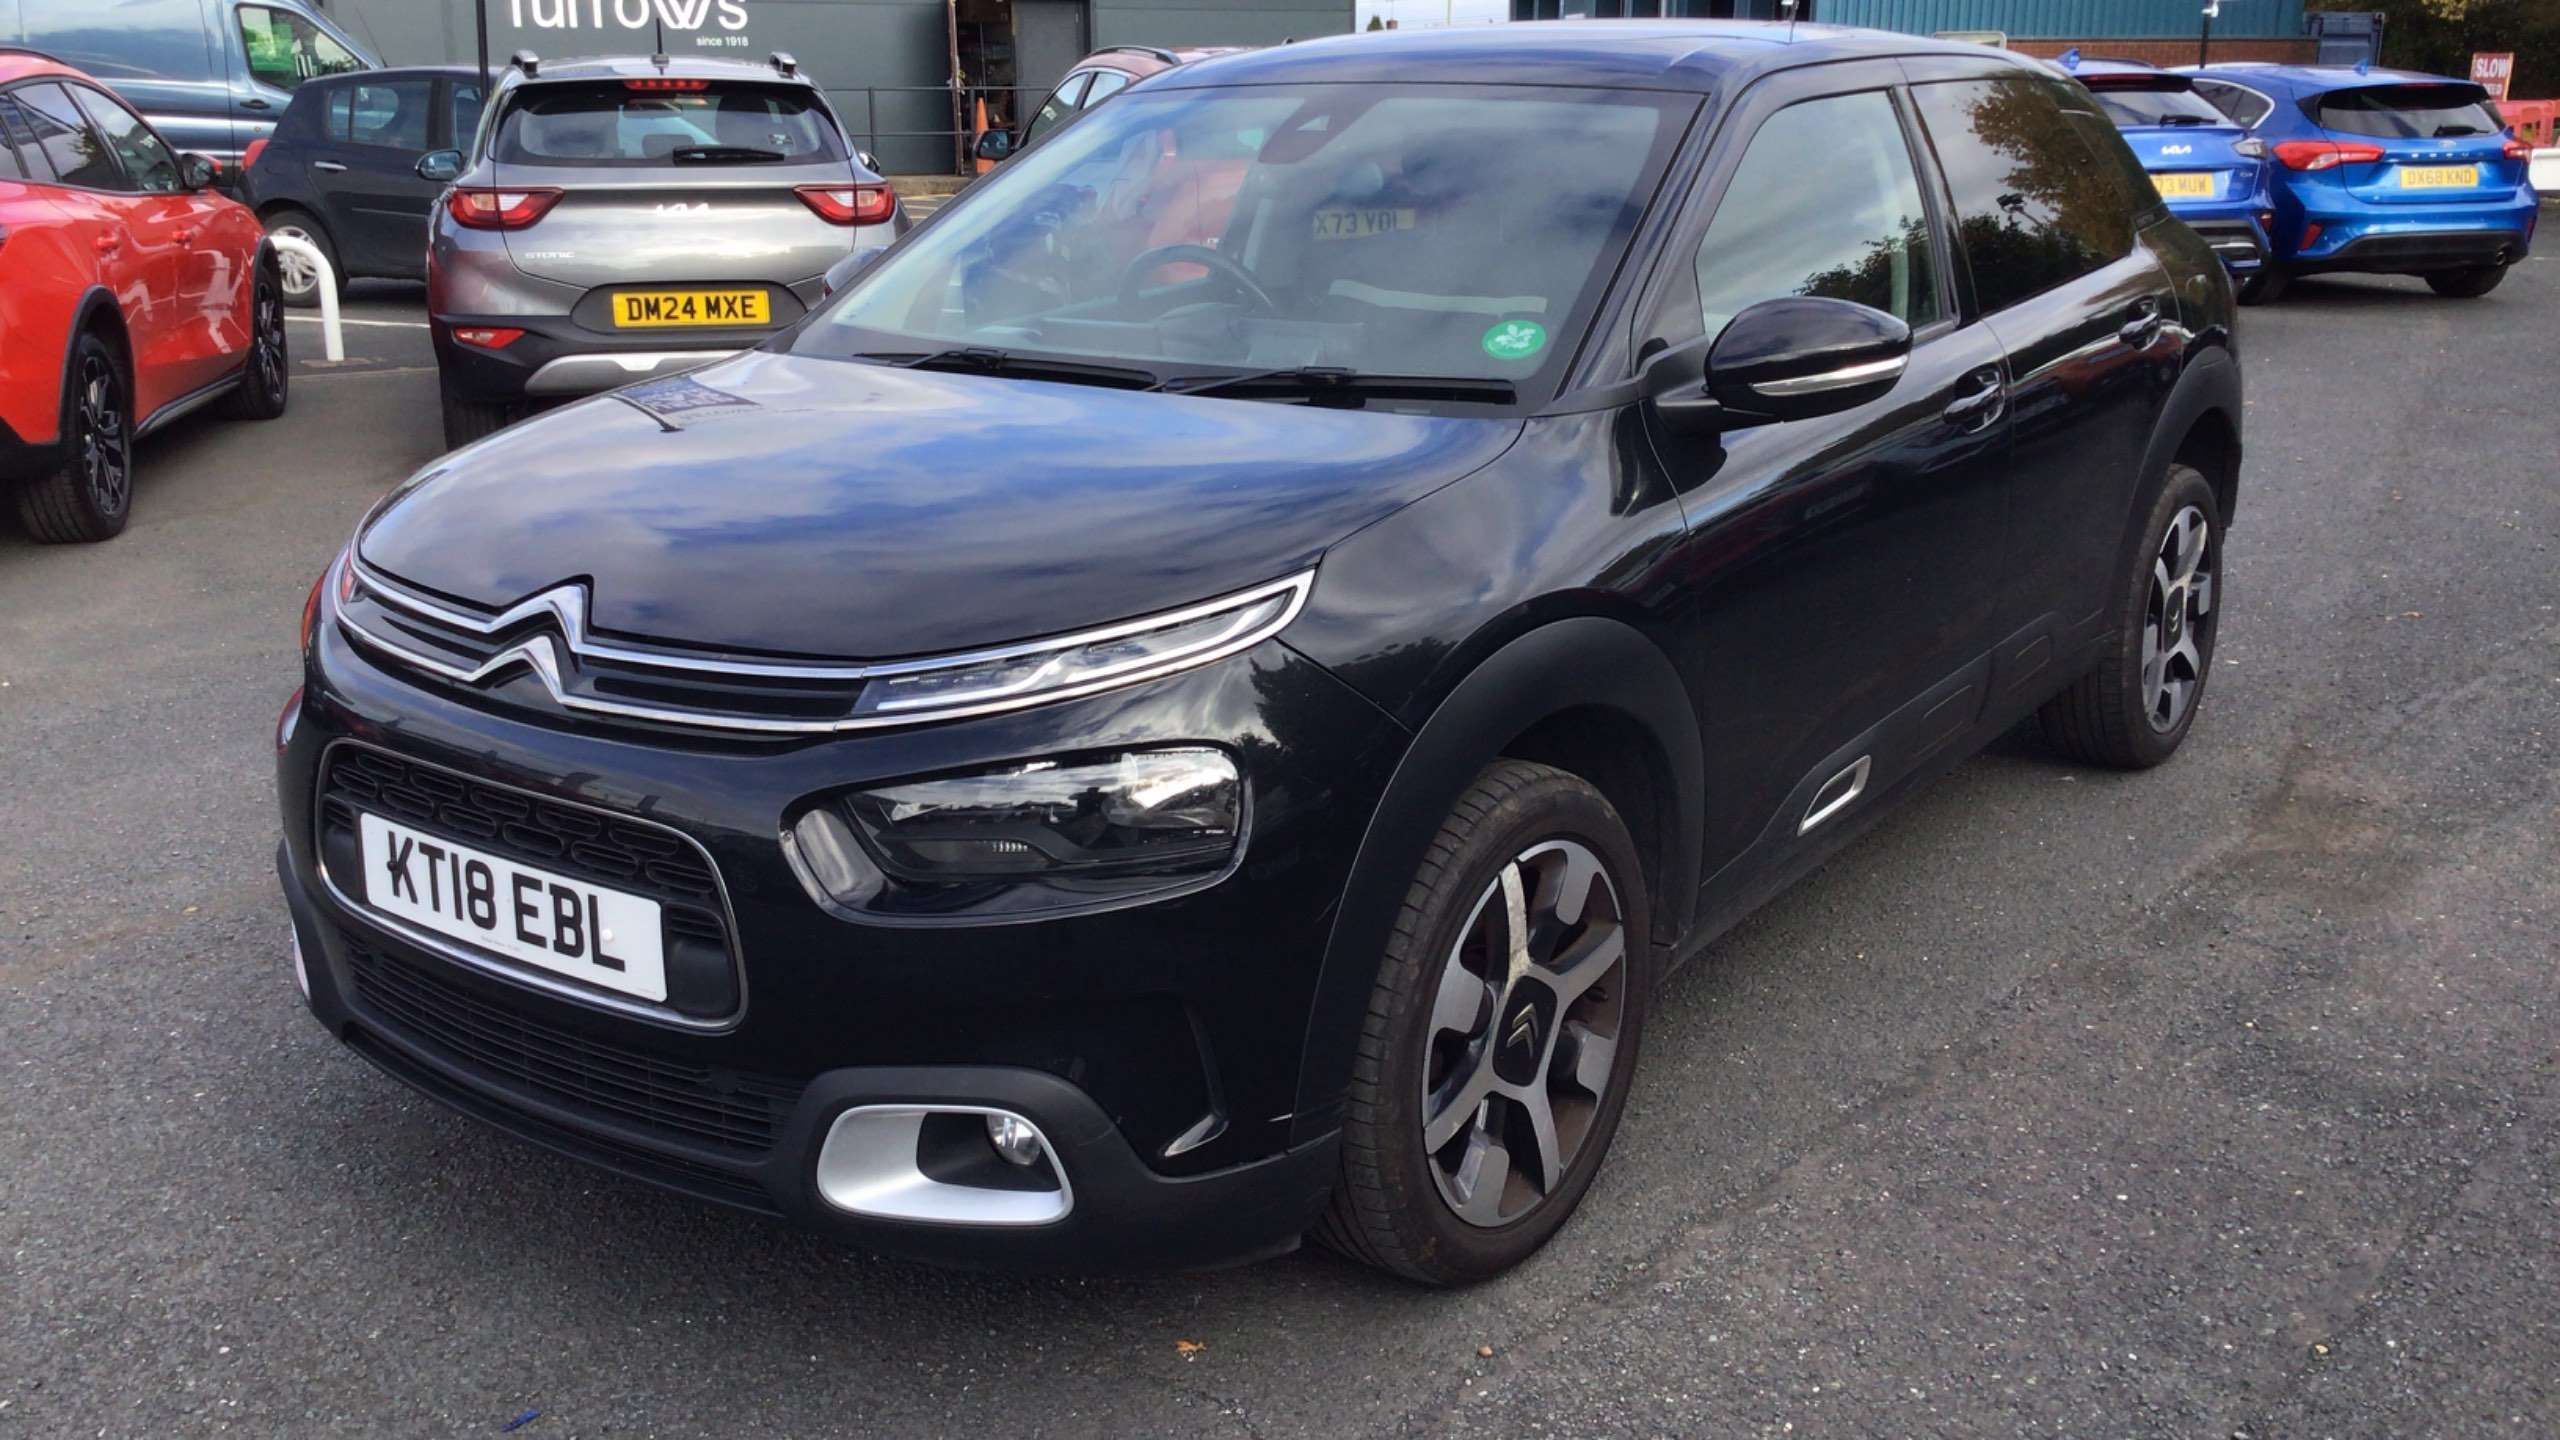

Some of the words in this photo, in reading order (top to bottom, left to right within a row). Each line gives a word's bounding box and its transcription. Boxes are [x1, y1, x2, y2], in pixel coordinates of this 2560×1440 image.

[695, 36, 722, 46] since
[725, 36, 749, 46] 1918
[2476, 58, 2508, 78] SLOW
[625, 296, 697, 321] DM24
[704, 294, 758, 320] MXE
[386, 829, 498, 931] KT18
[511, 871, 627, 973] EBL
